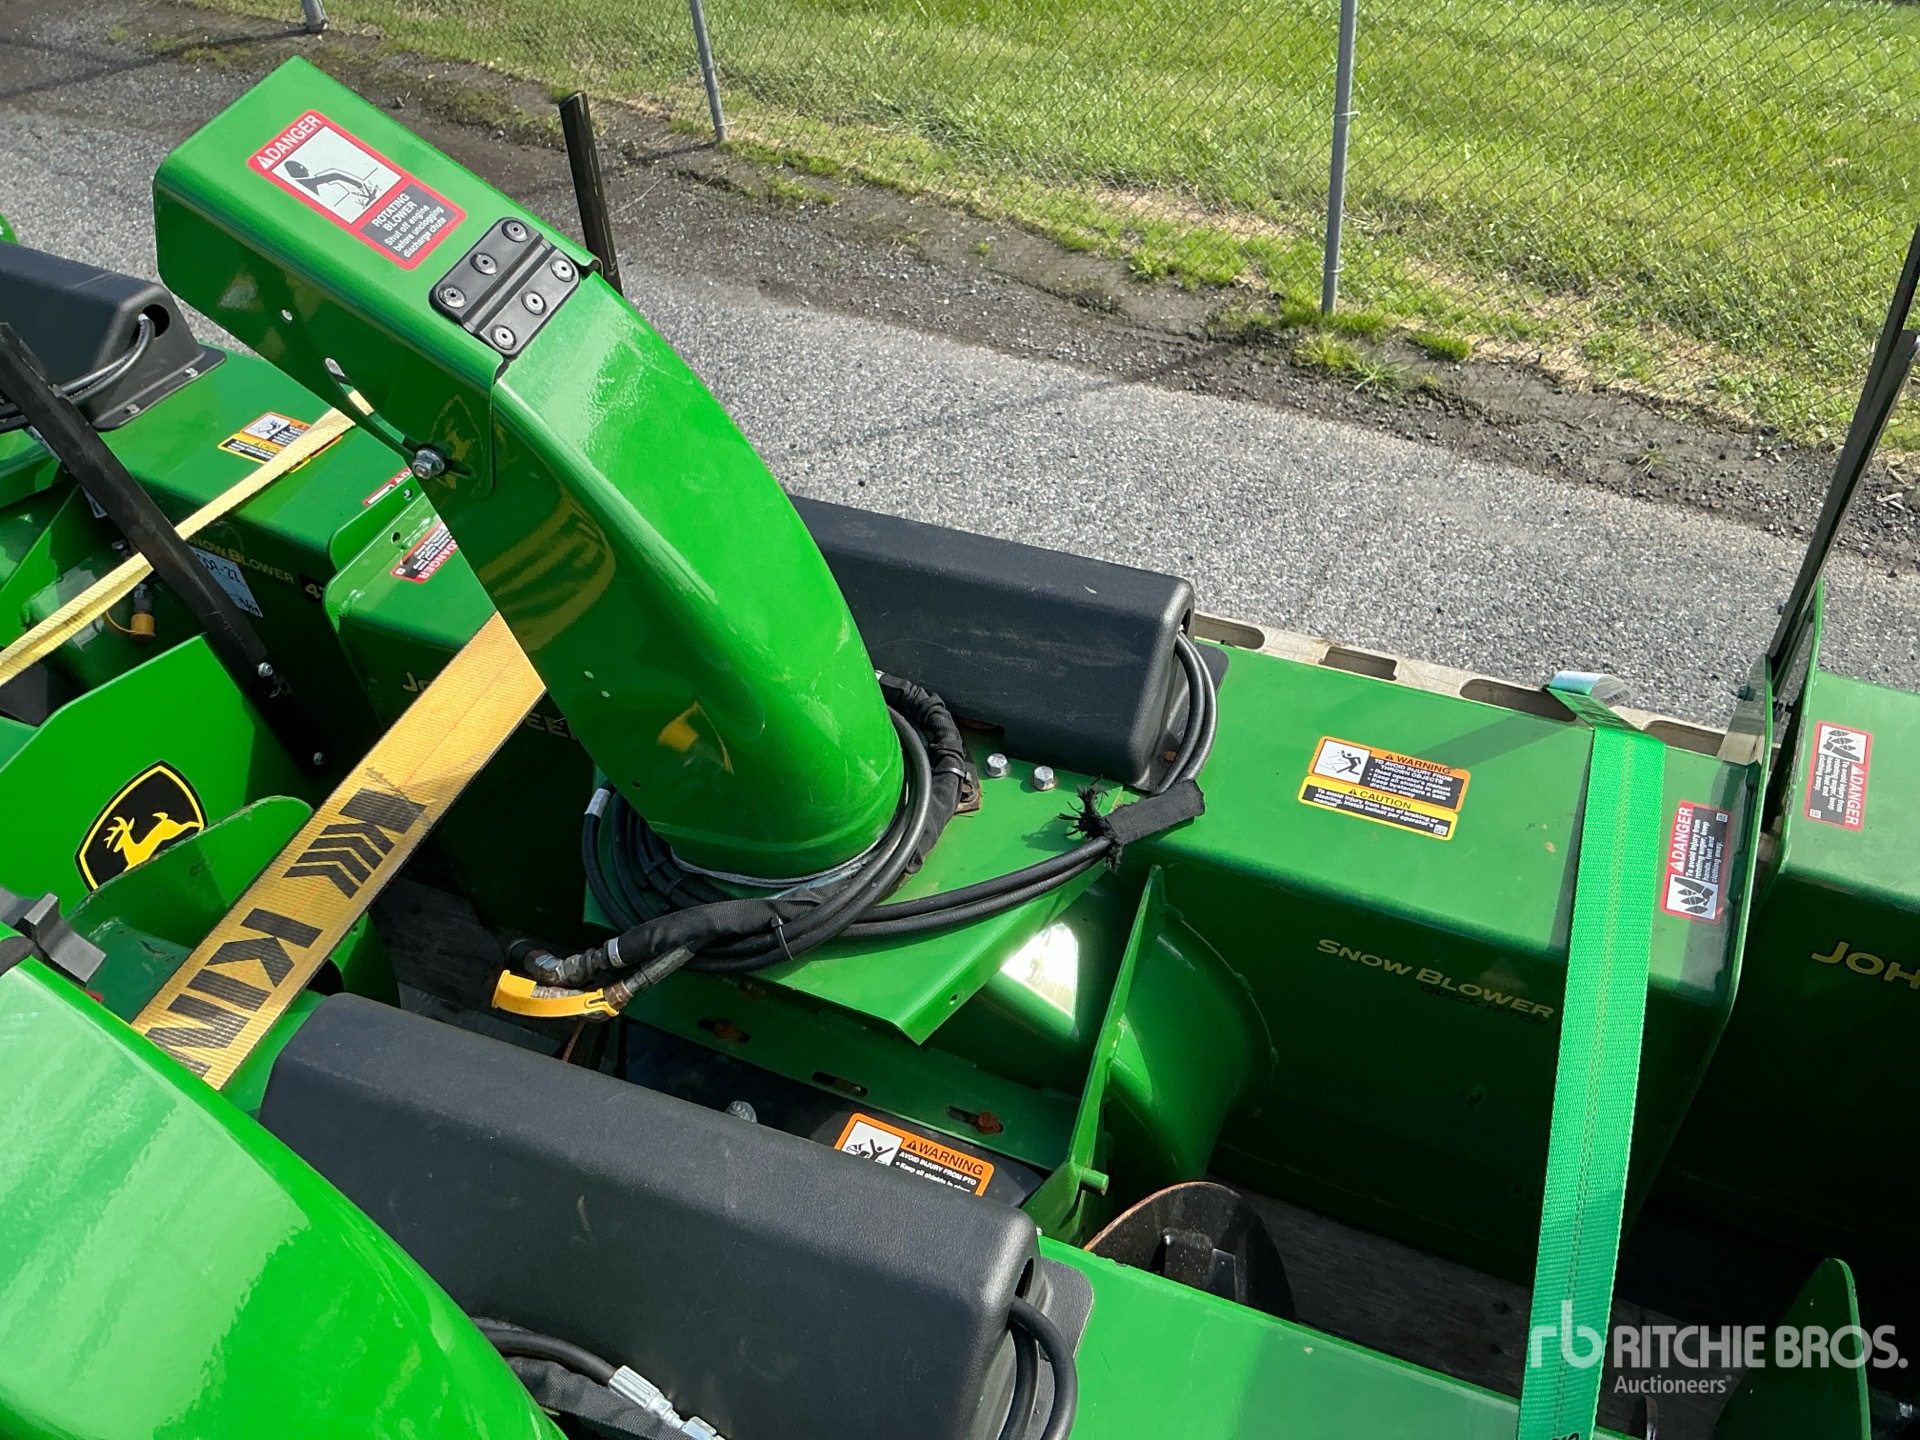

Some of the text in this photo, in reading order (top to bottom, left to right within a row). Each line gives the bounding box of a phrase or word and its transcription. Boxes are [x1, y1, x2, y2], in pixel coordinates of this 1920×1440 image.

[267, 115, 322, 160] DANGER
[371, 193, 411, 227] ROTATING
[382, 200, 418, 231] BLOWER
[384, 230, 402, 246] Shut
[400, 221, 411, 232] off
[408, 205, 430, 224] engine
[393, 233, 415, 252] before
[412, 206, 445, 235] unclogging
[403, 230, 432, 258] discharge
[429, 217, 447, 233] chute
[228, 548, 295, 584] BLOWER
[418, 540, 457, 579] DANGER
[1381, 764, 1443, 785] THROWN OBJECTS
[1385, 761, 1405, 770] AVOID
[1407, 766, 1431, 776] INJURY
[1432, 772, 1453, 782] FROM
[1397, 755, 1451, 774] WARNING
[1371, 777, 1388, 786] Keep
[1389, 782, 1426, 795] bystanders
[1373, 773, 1390, 782] Keep
[1400, 780, 1423, 790] shields
[1432, 788, 1451, 797] place
[1392, 773, 1425, 786] operator's
[1426, 782, 1451, 792] manual
[1398, 790, 1415, 798] away
[1313, 797, 1338, 807] manual
[1360, 790, 1412, 809] CAUTION
[1845, 776, 1865, 825] DANGER
[1344, 800, 1364, 809] install
[1400, 815, 1434, 828] operator's
[1404, 810, 1430, 822] braking
[1692, 819, 1701, 833] from
[1671, 807, 1694, 860] DANGER
[1690, 833, 1701, 851] injury
[1687, 850, 1697, 868] avoid
[1711, 858, 1721, 883] clothing
[1811, 941, 1920, 989] JOH
[1317, 938, 1554, 1019] SNOW BLOWER
[899, 1151, 977, 1186] AVOID INJURY FROM PTO
[900, 1162, 916, 1173] Keep
[920, 1142, 984, 1175] WARNING
